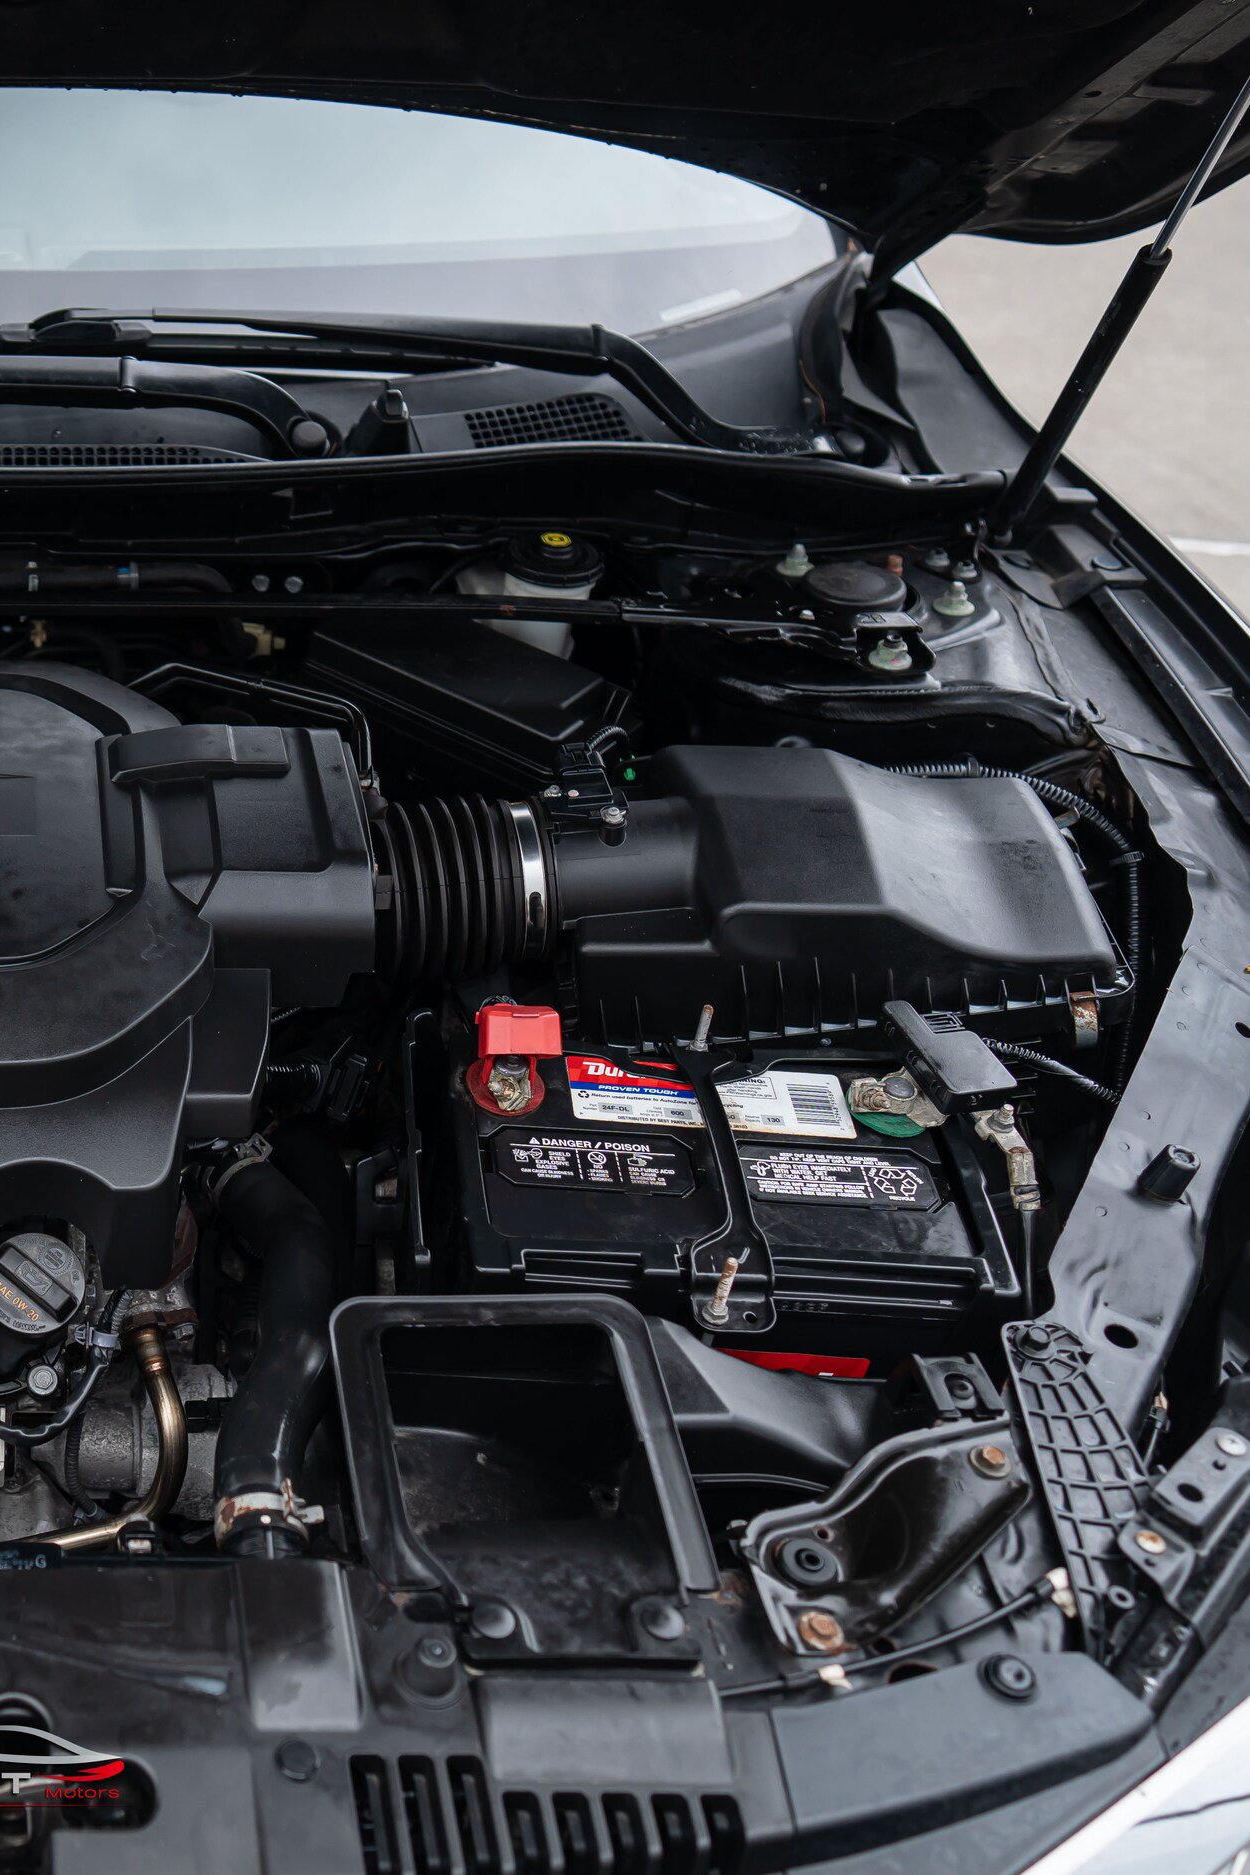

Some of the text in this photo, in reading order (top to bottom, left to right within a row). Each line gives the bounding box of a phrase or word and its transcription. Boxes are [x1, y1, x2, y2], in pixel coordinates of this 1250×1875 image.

[598, 1084, 680, 1096] PROVEN TOUGH
[602, 1104, 631, 1113] 24F-DL
[541, 1137, 592, 1149] DANGER
[604, 1142, 651, 1153] POISON
